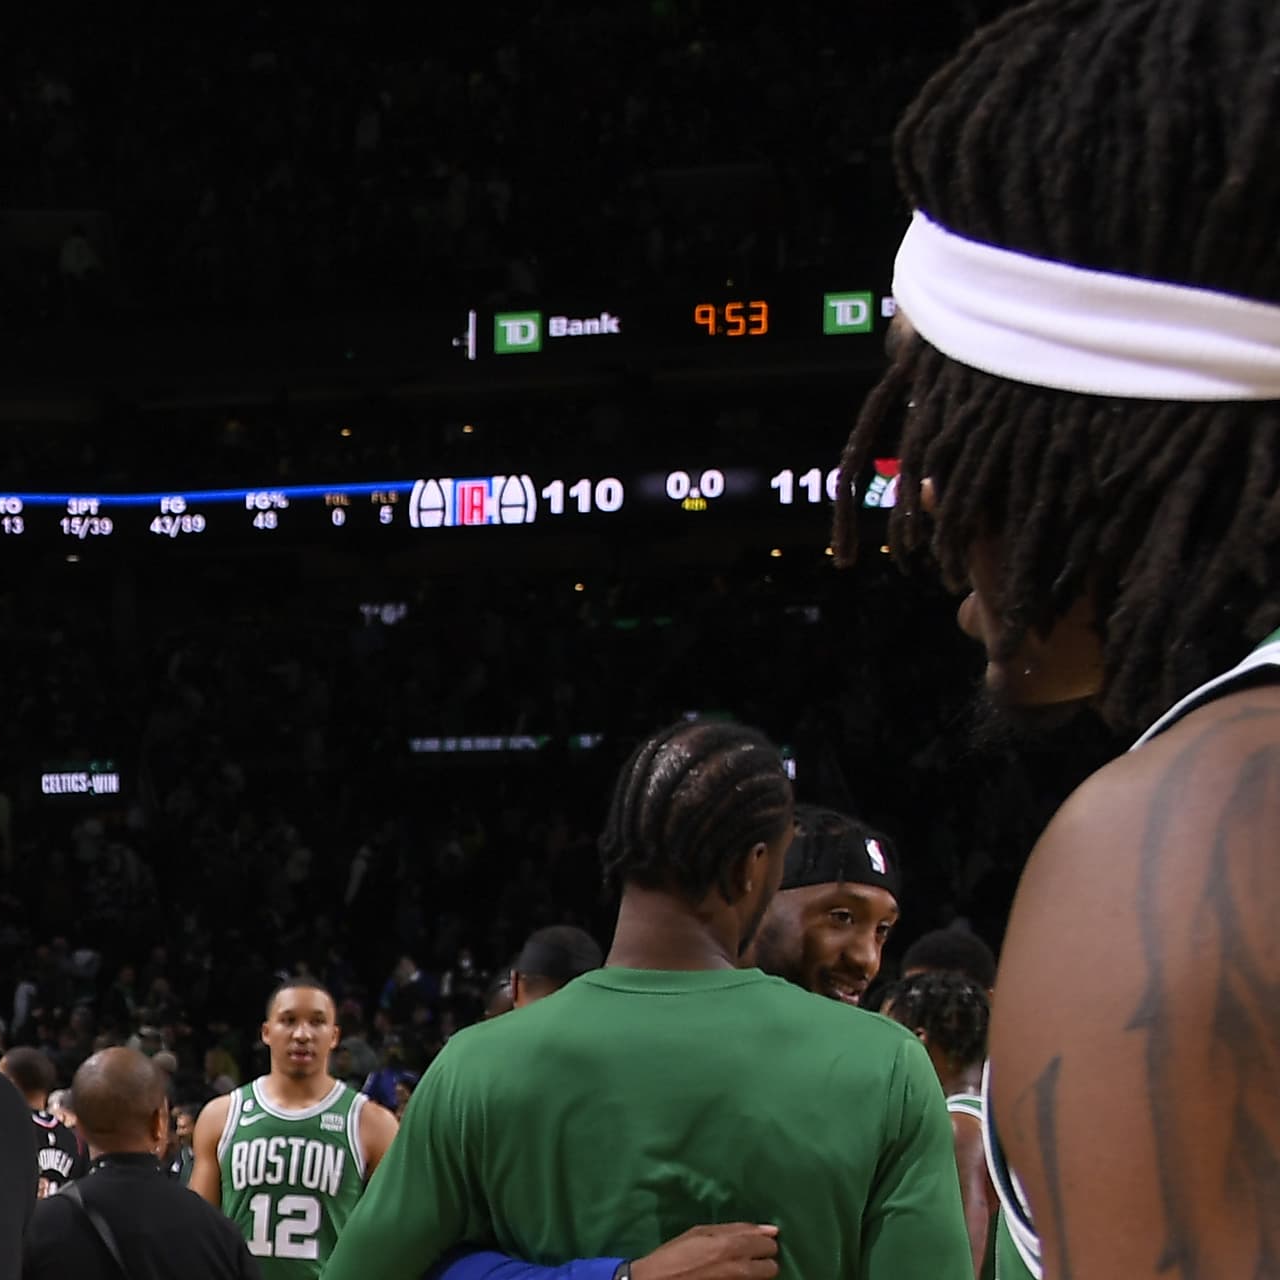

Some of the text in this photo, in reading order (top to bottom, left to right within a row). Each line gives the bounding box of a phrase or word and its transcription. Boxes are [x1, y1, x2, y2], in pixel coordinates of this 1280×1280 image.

[548, 311, 620, 337] Bank
[541, 476, 625, 515] 110
[665, 468, 725, 500] 0.0
[66, 497, 101, 516] 3PT
[159, 495, 187, 514] FG
[245, 491, 290, 511] FG%
[0, 515, 25, 535] 13
[59, 515, 115, 540] 15/39
[149, 513, 207, 539] 43/89
[251, 510, 279, 530] 48
[331, 507, 346, 527] 0
[379, 505, 394, 525] 5
[41, 772, 89, 794] CELTICS
[232, 1137, 346, 1197] BOSTON
[246, 1193, 322, 1261] 12
